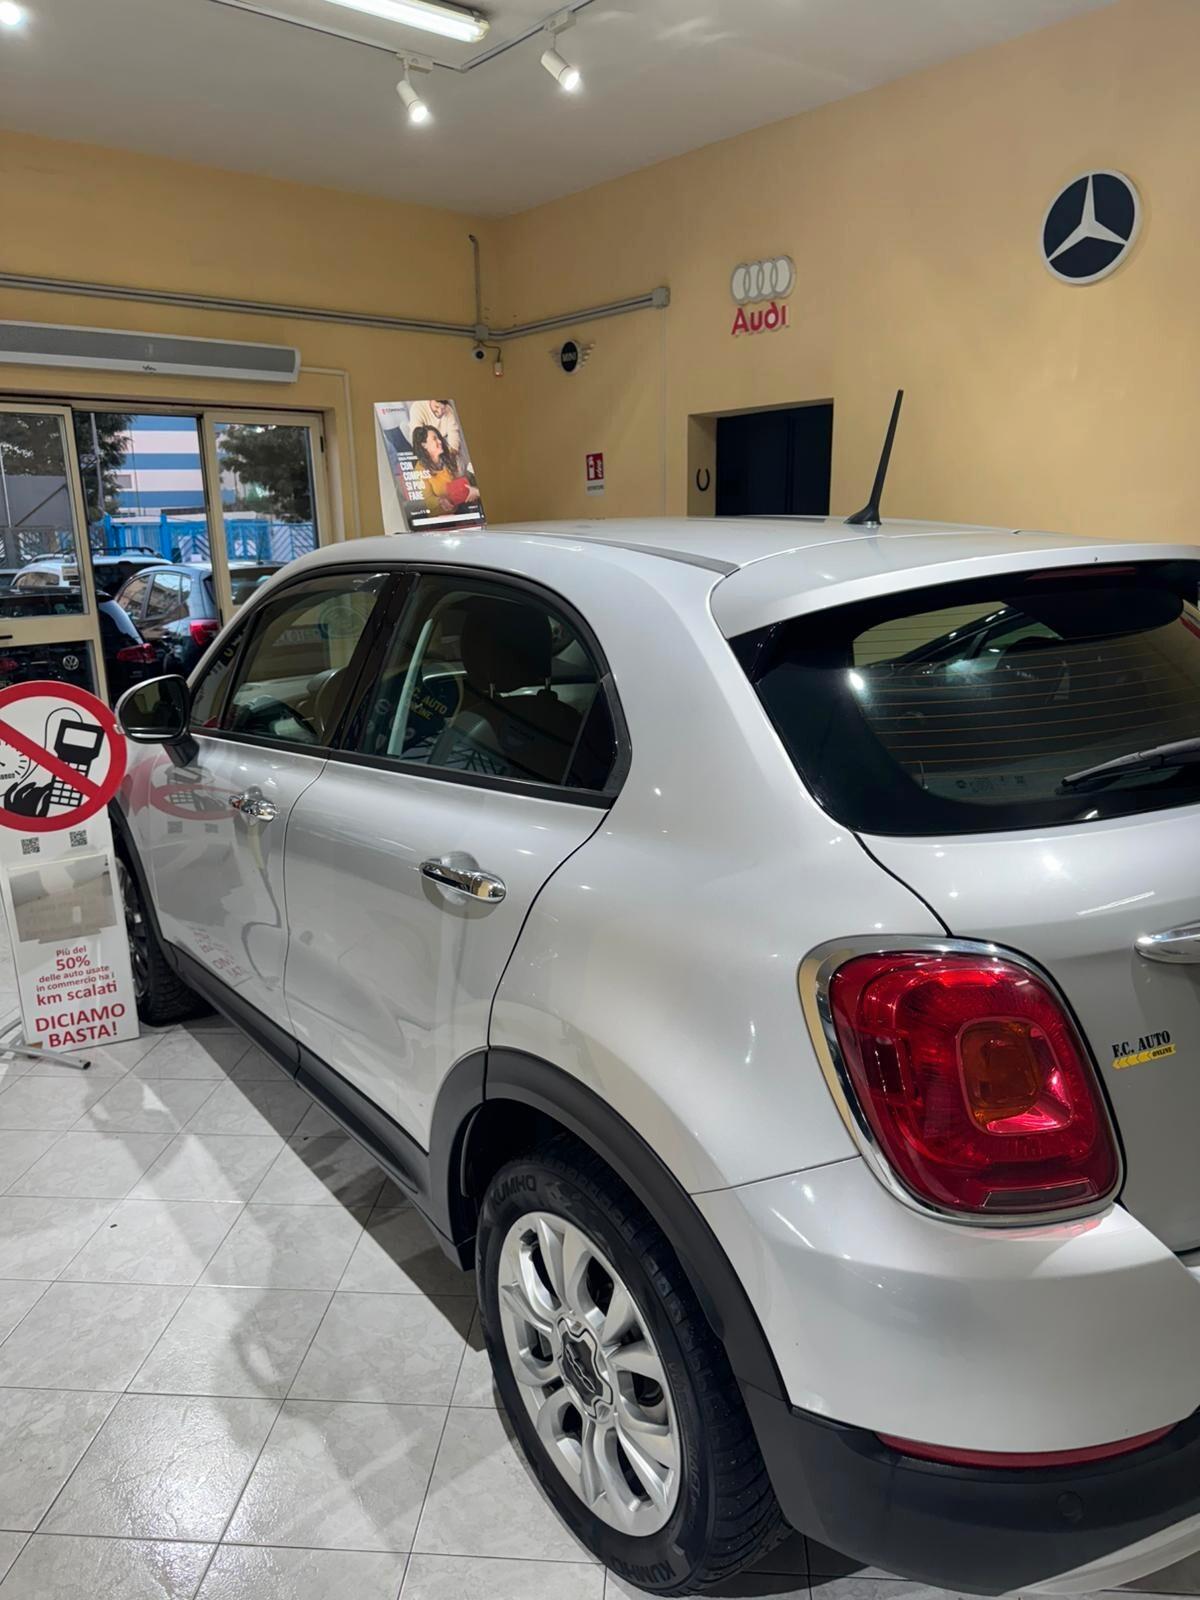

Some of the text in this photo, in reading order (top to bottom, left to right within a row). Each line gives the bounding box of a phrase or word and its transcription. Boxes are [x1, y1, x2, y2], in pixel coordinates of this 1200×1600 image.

[731, 302, 786, 335] Audi
[73, 945, 87, 954] del
[56, 954, 90, 971] 50%
[39, 965, 109, 983] delle auto usate
[47, 975, 96, 990] commercio
[36, 980, 117, 1006] km scalati
[35, 1003, 125, 1032] DICIAMO
[48, 1021, 118, 1048] BASTA!
[1112, 1030, 1171, 1058] F.C. AUTO
[1152, 1046, 1173, 1057] ONLINE
